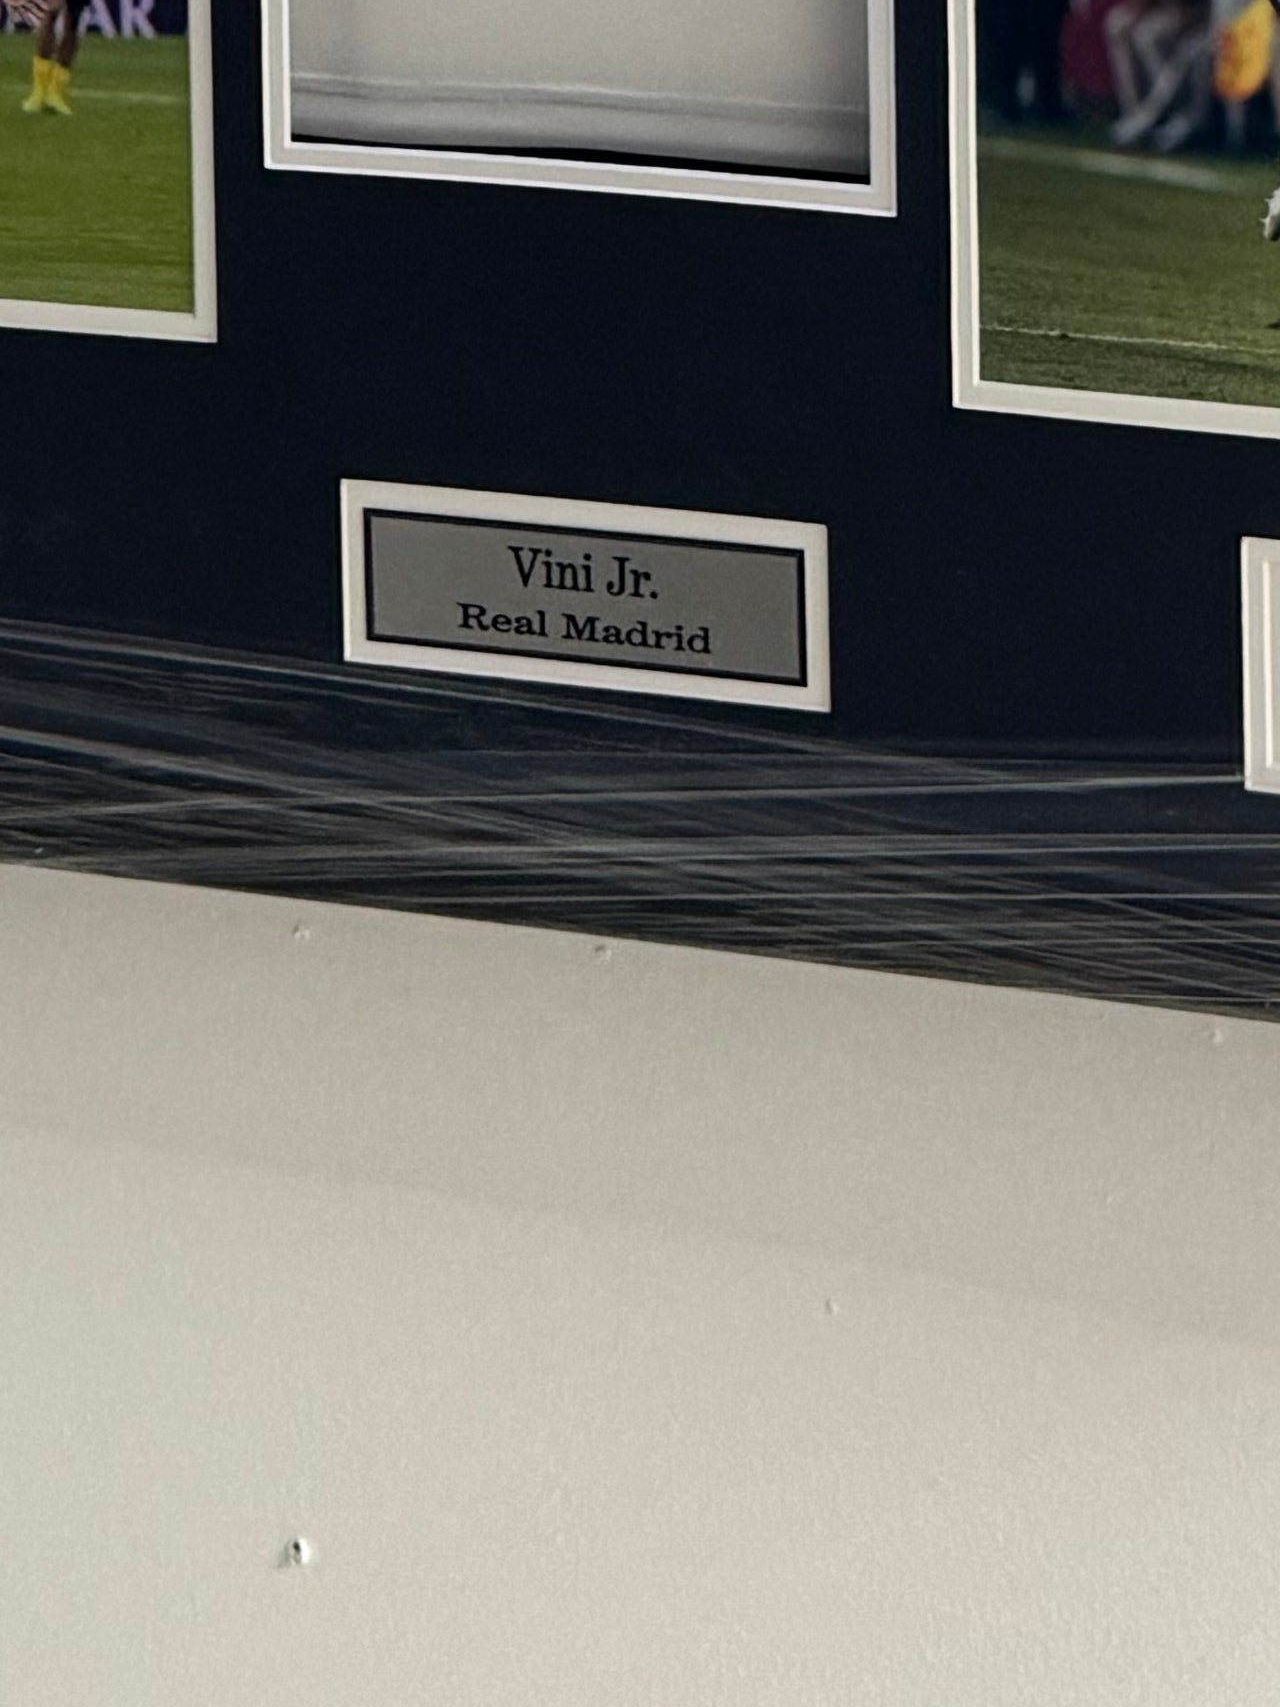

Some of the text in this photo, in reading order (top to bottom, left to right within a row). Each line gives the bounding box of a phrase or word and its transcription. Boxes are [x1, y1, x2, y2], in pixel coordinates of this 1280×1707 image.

[508, 546, 659, 600] Vini Jr.
[457, 602, 712, 654] Real Madrid
